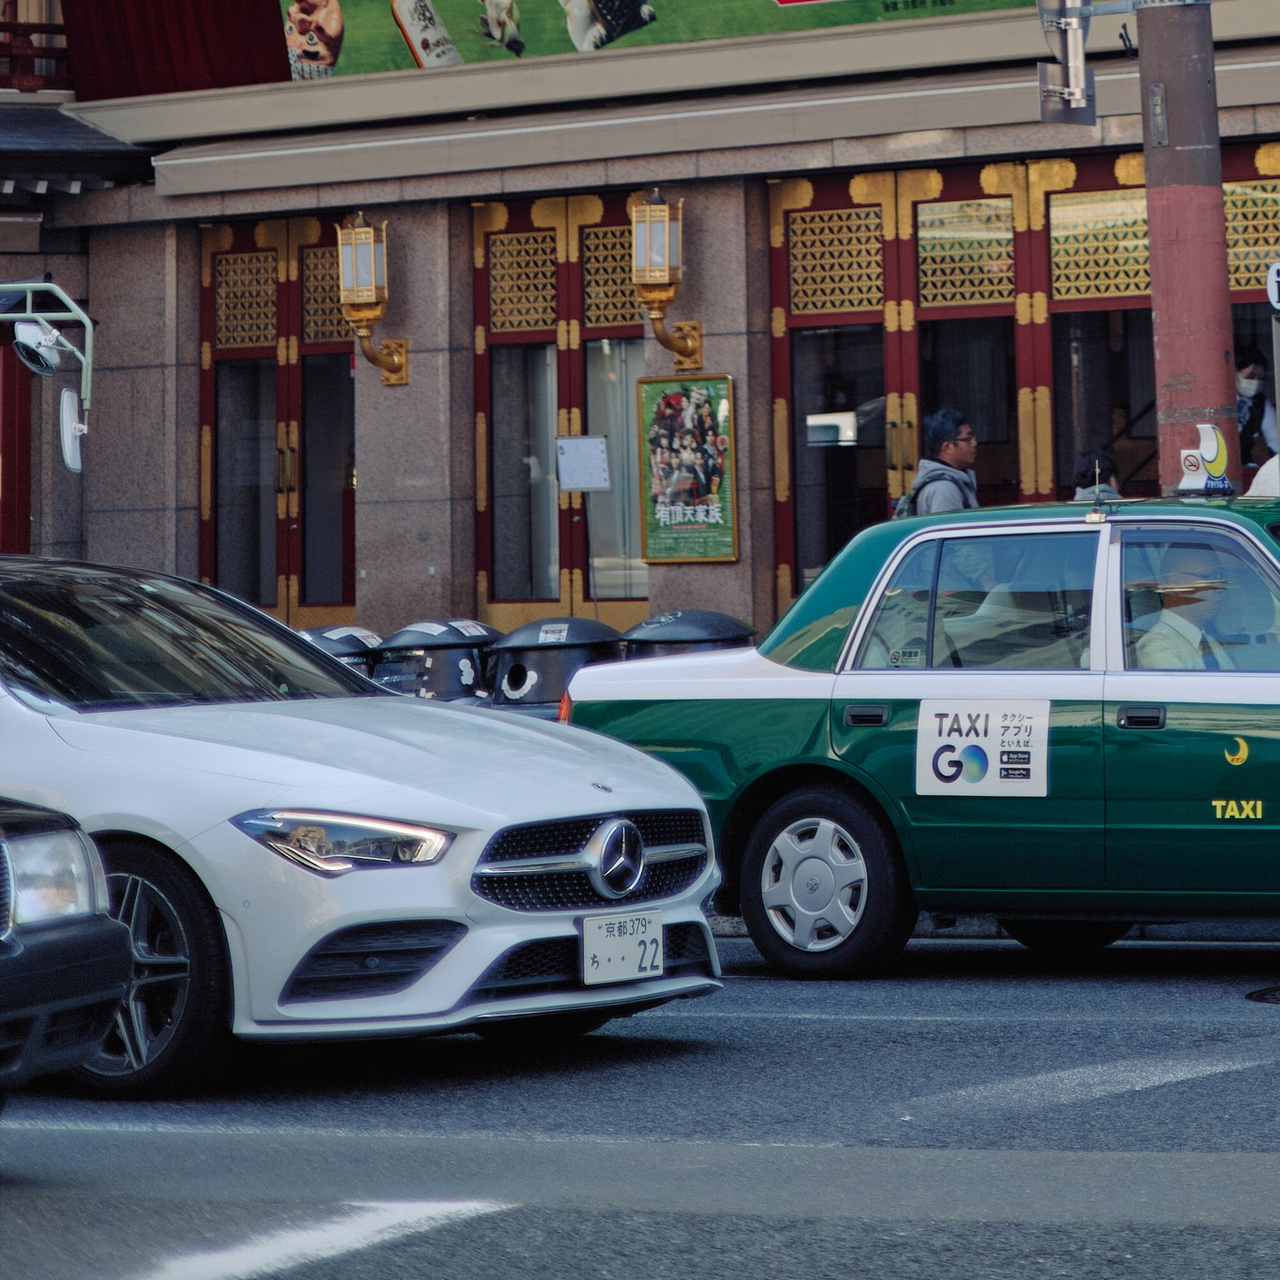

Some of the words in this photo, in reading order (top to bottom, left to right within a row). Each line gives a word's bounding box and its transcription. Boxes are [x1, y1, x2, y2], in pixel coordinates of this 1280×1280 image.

[934, 713, 990, 738] TAXI
[1001, 713, 1034, 723] タクシー
[1000, 724, 1033, 737] アプリ
[1211, 800, 1262, 819] TAXI
[605, 917, 647, 938] 京都379
[591, 953, 600, 970] ち
[637, 937, 660, 973] 22
